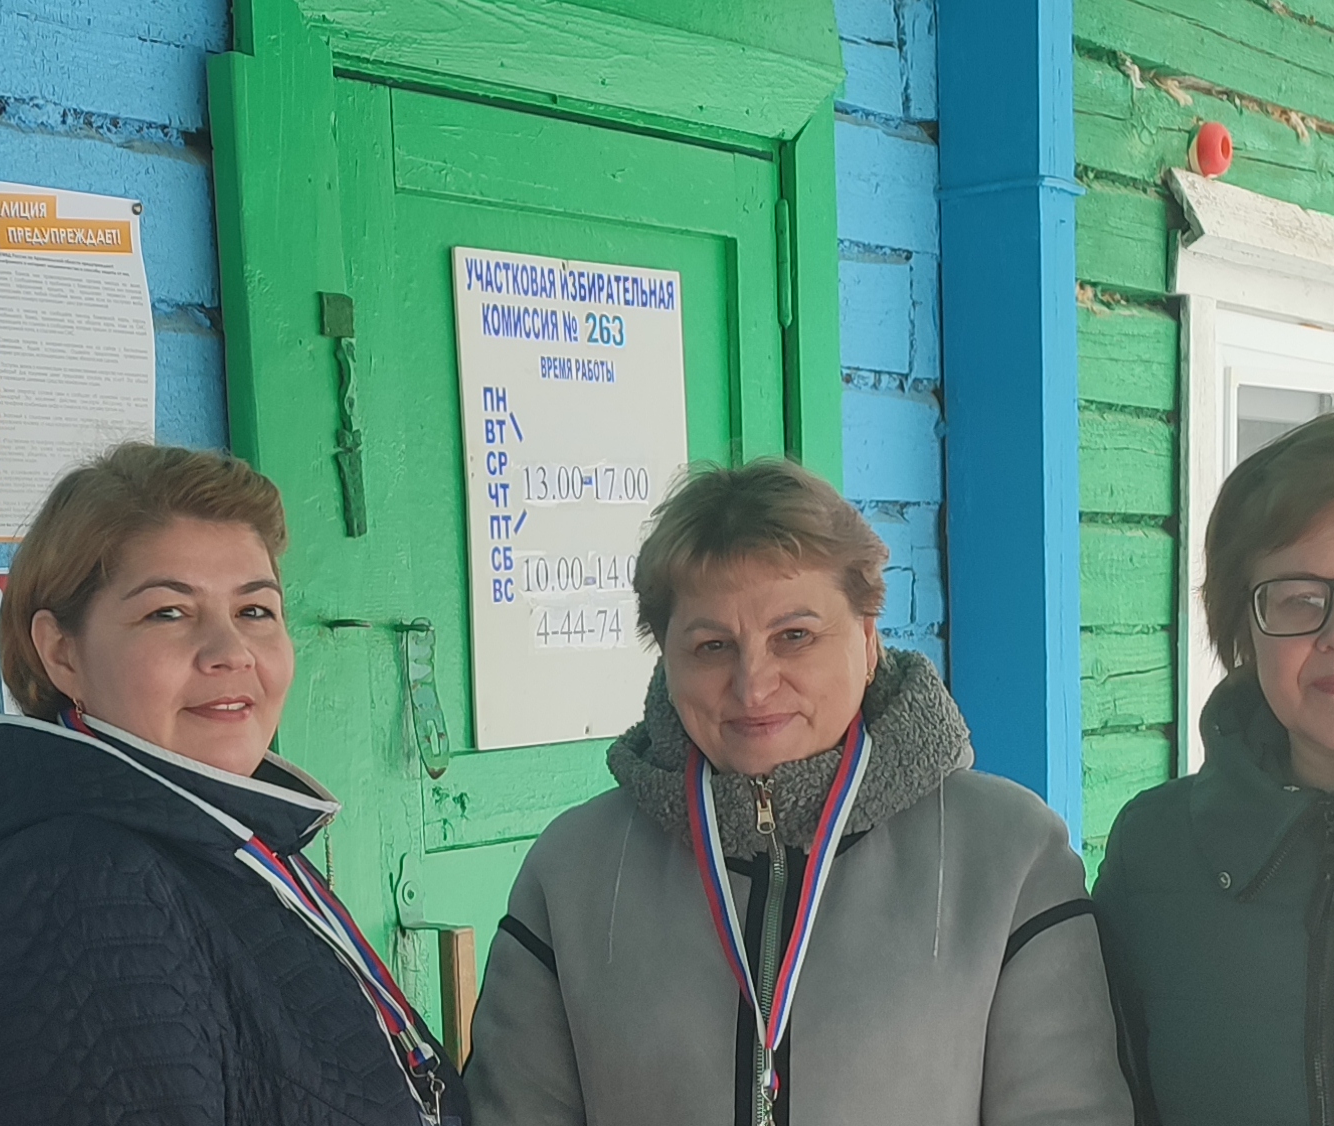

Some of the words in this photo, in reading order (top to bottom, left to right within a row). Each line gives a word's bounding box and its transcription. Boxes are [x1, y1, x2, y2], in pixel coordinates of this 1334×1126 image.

[6, 226, 121, 246] ПРЕДУПРЕЖДАЕТ!
[465, 257, 556, 299] УЧАСТКОВАЯ
[559, 268, 675, 310] ИЗБИРАТЕЛЬНАЯ
[481, 303, 559, 341] КОМИССИЯ
[563, 311, 579, 342] №
[585, 312, 625, 347] 263
[540, 356, 573, 379] ВРЕМЯ
[575, 359, 615, 382] РАБОТЫ
[483, 387, 507, 412] ПН
[485, 419, 506, 444] ВТ
[486, 451, 508, 476] СР
[488, 483, 509, 508] ЧТ
[523, 466, 649, 501] 13.00-17.00
[490, 515, 512, 539] ПТ
[491, 547, 513, 571] СБ
[523, 555, 637, 592] 10.00-14.0
[492, 578, 514, 602] ВС
[536, 609, 621, 645] 4-44-74
